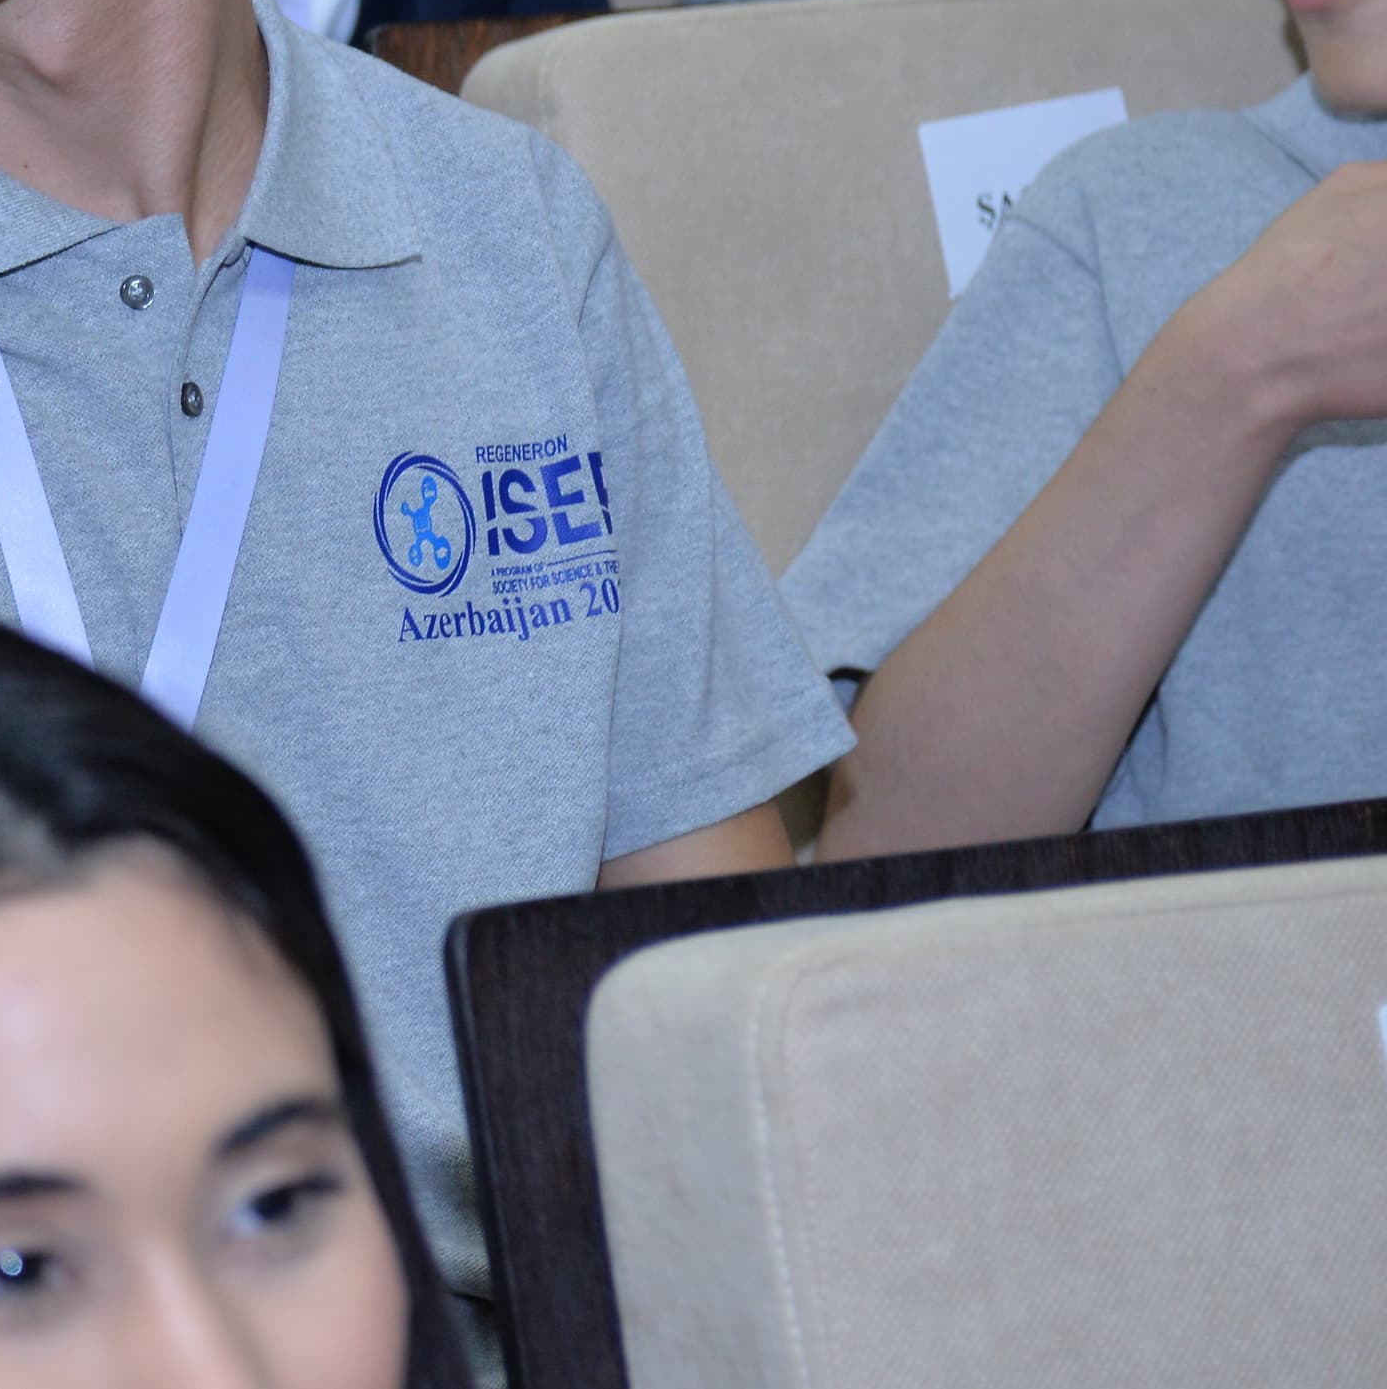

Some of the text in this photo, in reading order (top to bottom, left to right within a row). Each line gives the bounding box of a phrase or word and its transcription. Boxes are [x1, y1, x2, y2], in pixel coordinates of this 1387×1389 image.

[475, 433, 568, 463] REGENERON
[492, 578, 529, 595] SOCIETY
[530, 574, 550, 590] FOR
[551, 563, 594, 585] SCIENCE
[398, 577, 622, 642] Azerbaijan 20
